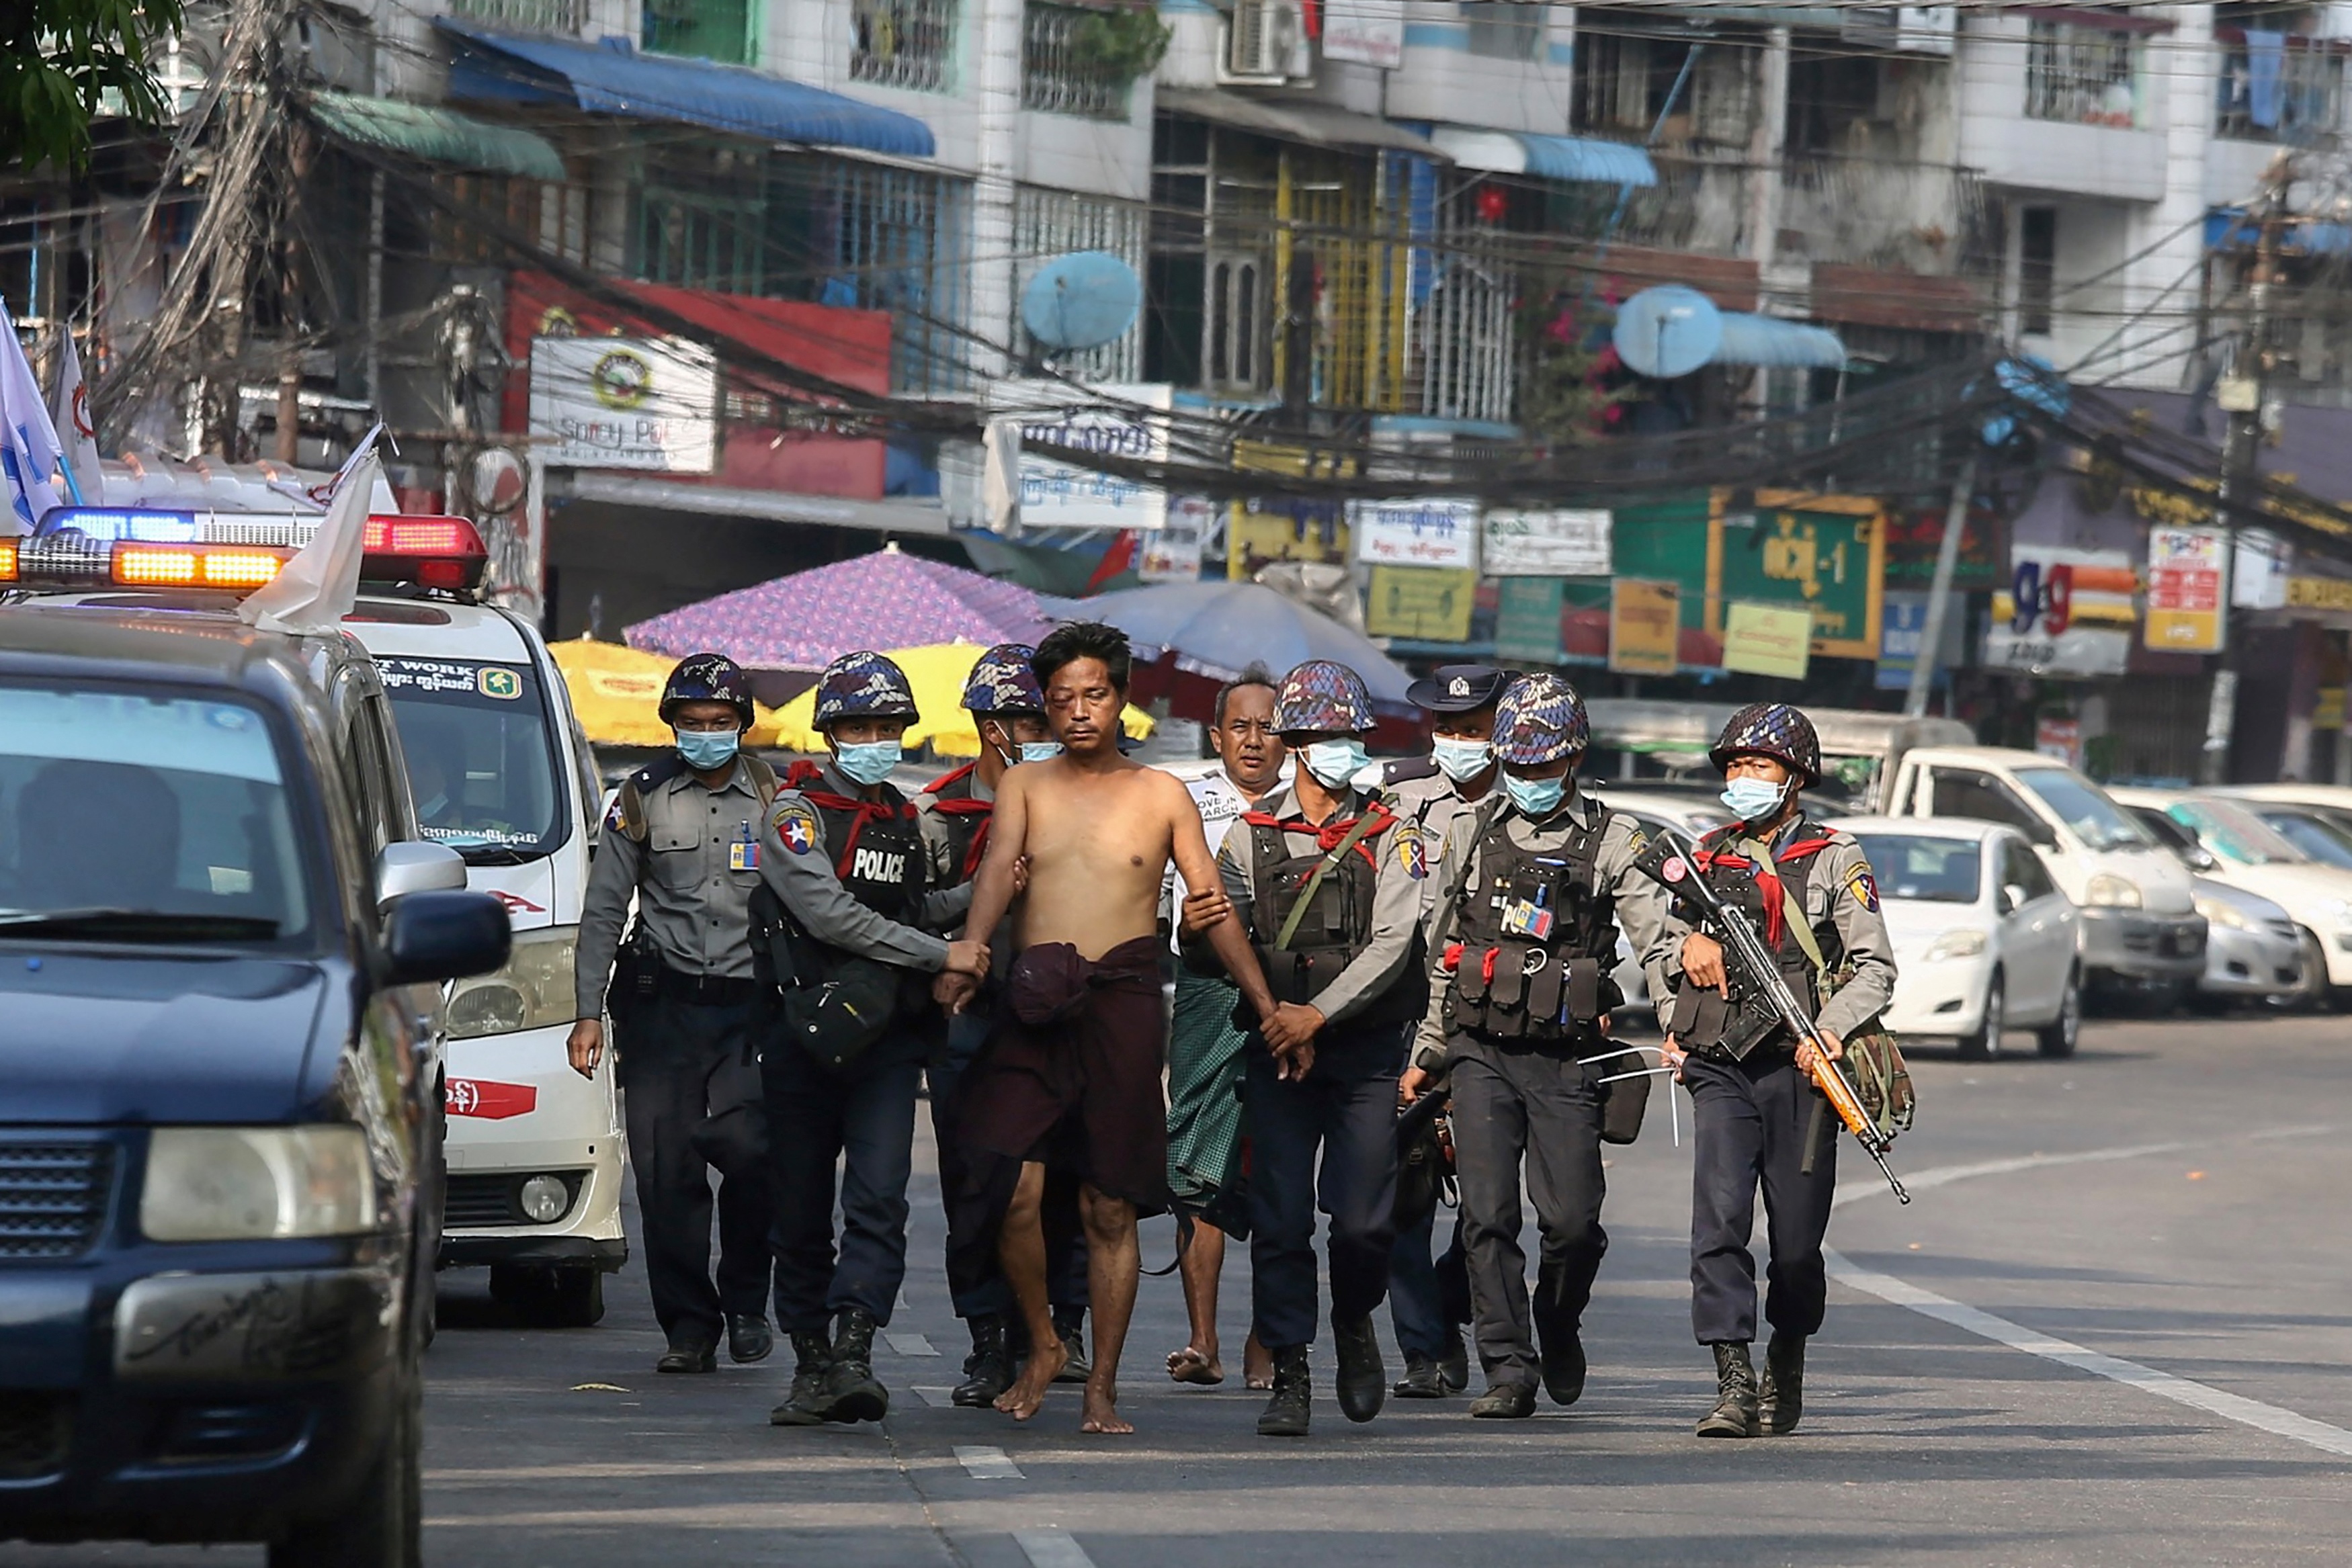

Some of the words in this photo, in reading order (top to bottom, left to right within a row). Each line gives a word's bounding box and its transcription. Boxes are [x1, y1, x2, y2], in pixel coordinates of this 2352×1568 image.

[374, 658, 395, 669] T
[400, 660, 476, 677] WORK
[1197, 797, 1222, 809] OVE
[1204, 805, 1239, 818] ARCH
[852, 847, 905, 883] POLICE
